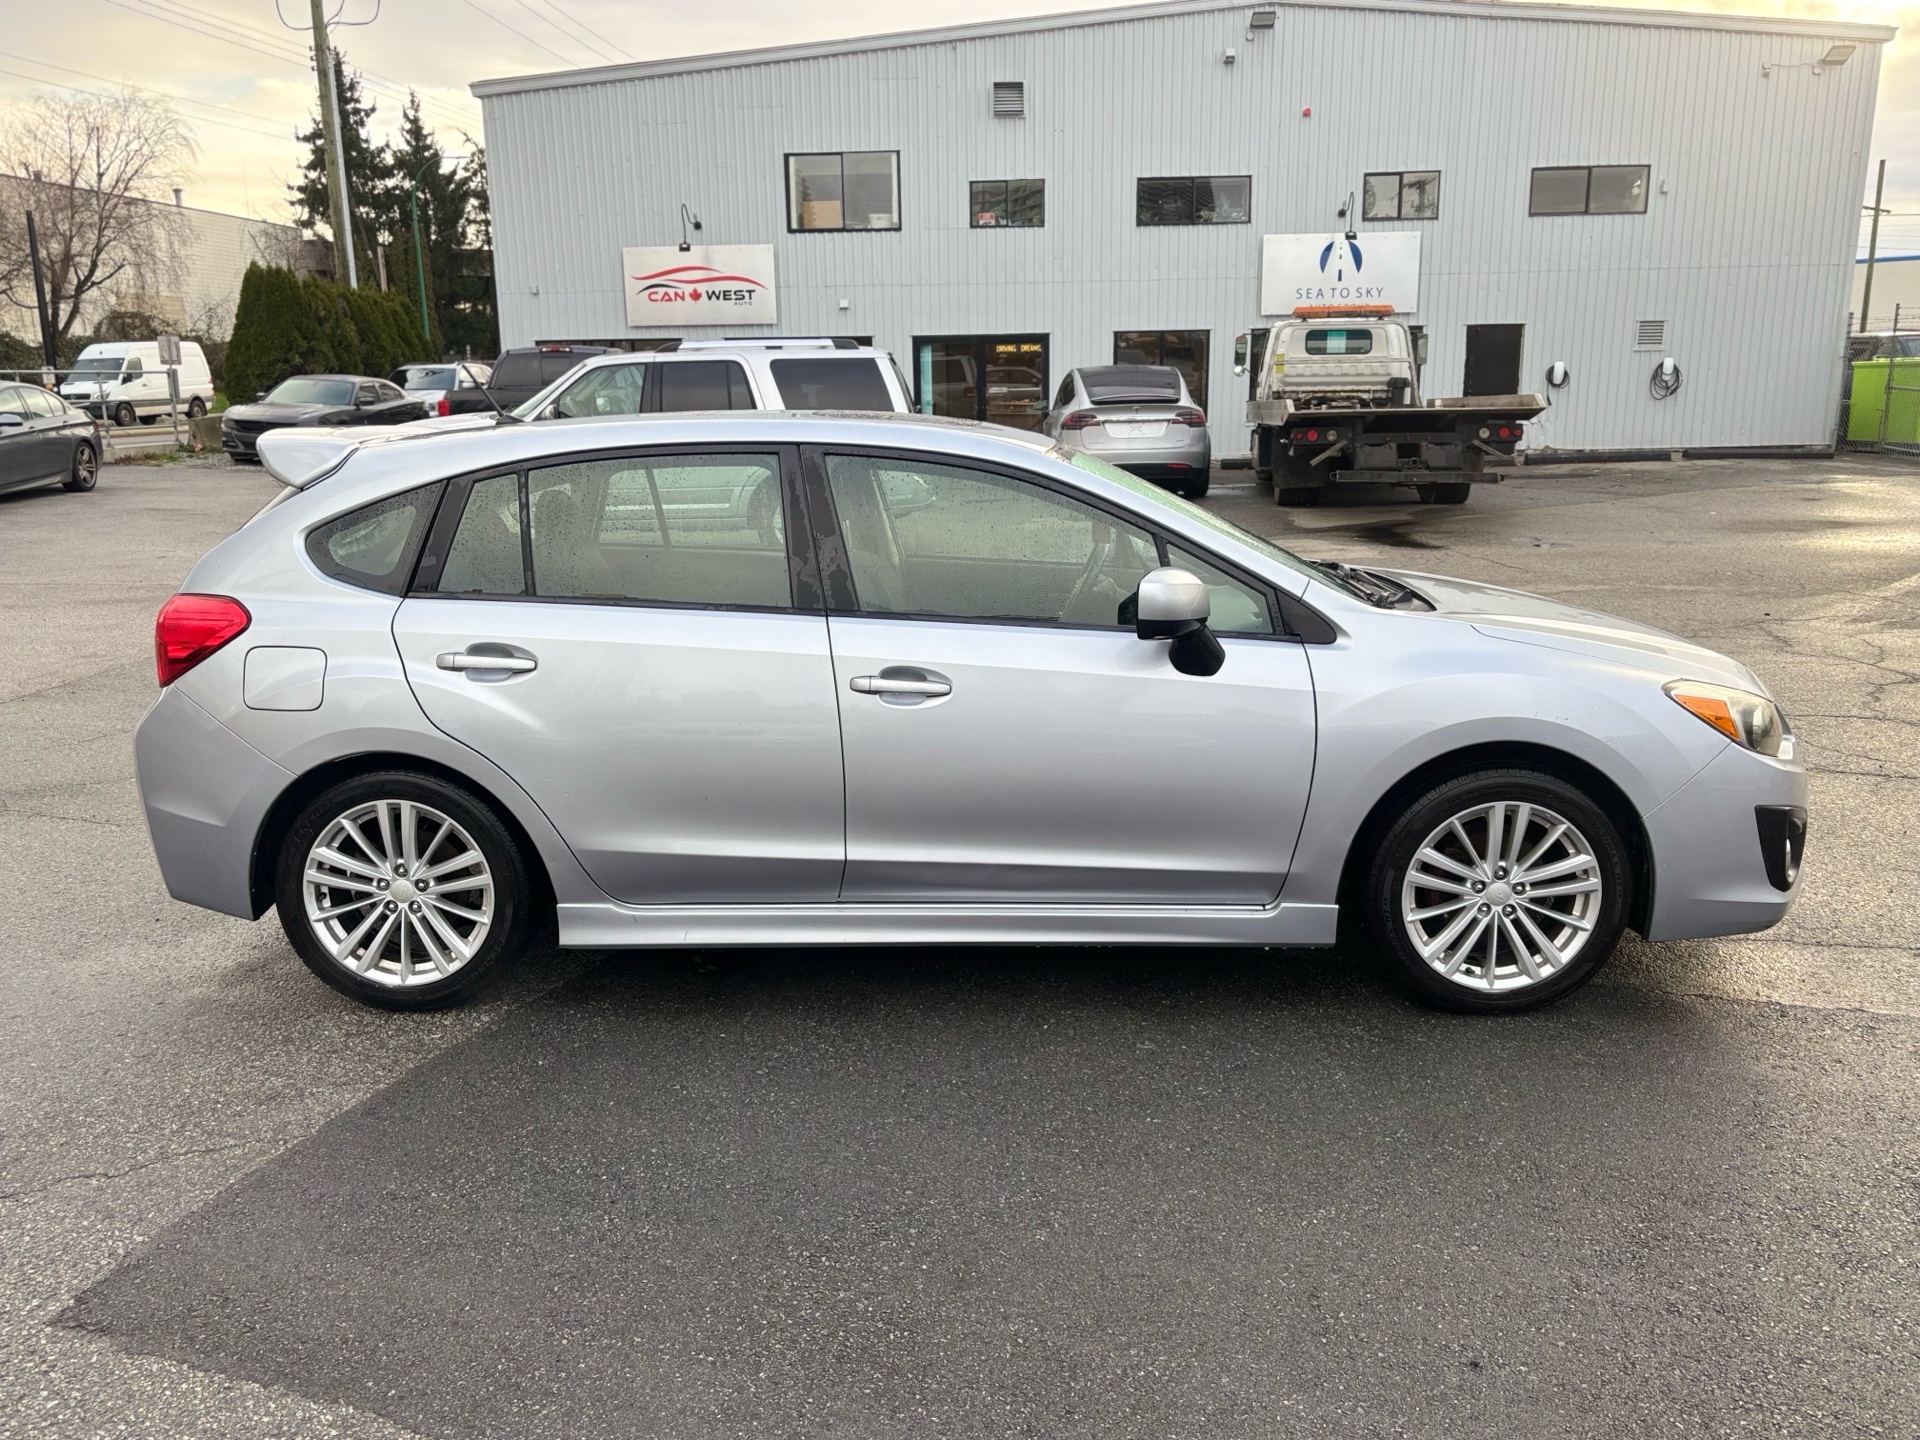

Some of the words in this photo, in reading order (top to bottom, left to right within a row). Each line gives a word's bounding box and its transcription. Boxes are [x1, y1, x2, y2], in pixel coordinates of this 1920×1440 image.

[648, 291, 686, 302] CAN
[705, 289, 756, 301] WEST
[1296, 288, 1325, 299] SEA
[1330, 287, 1350, 299] TO
[1355, 287, 1384, 298] SKY
